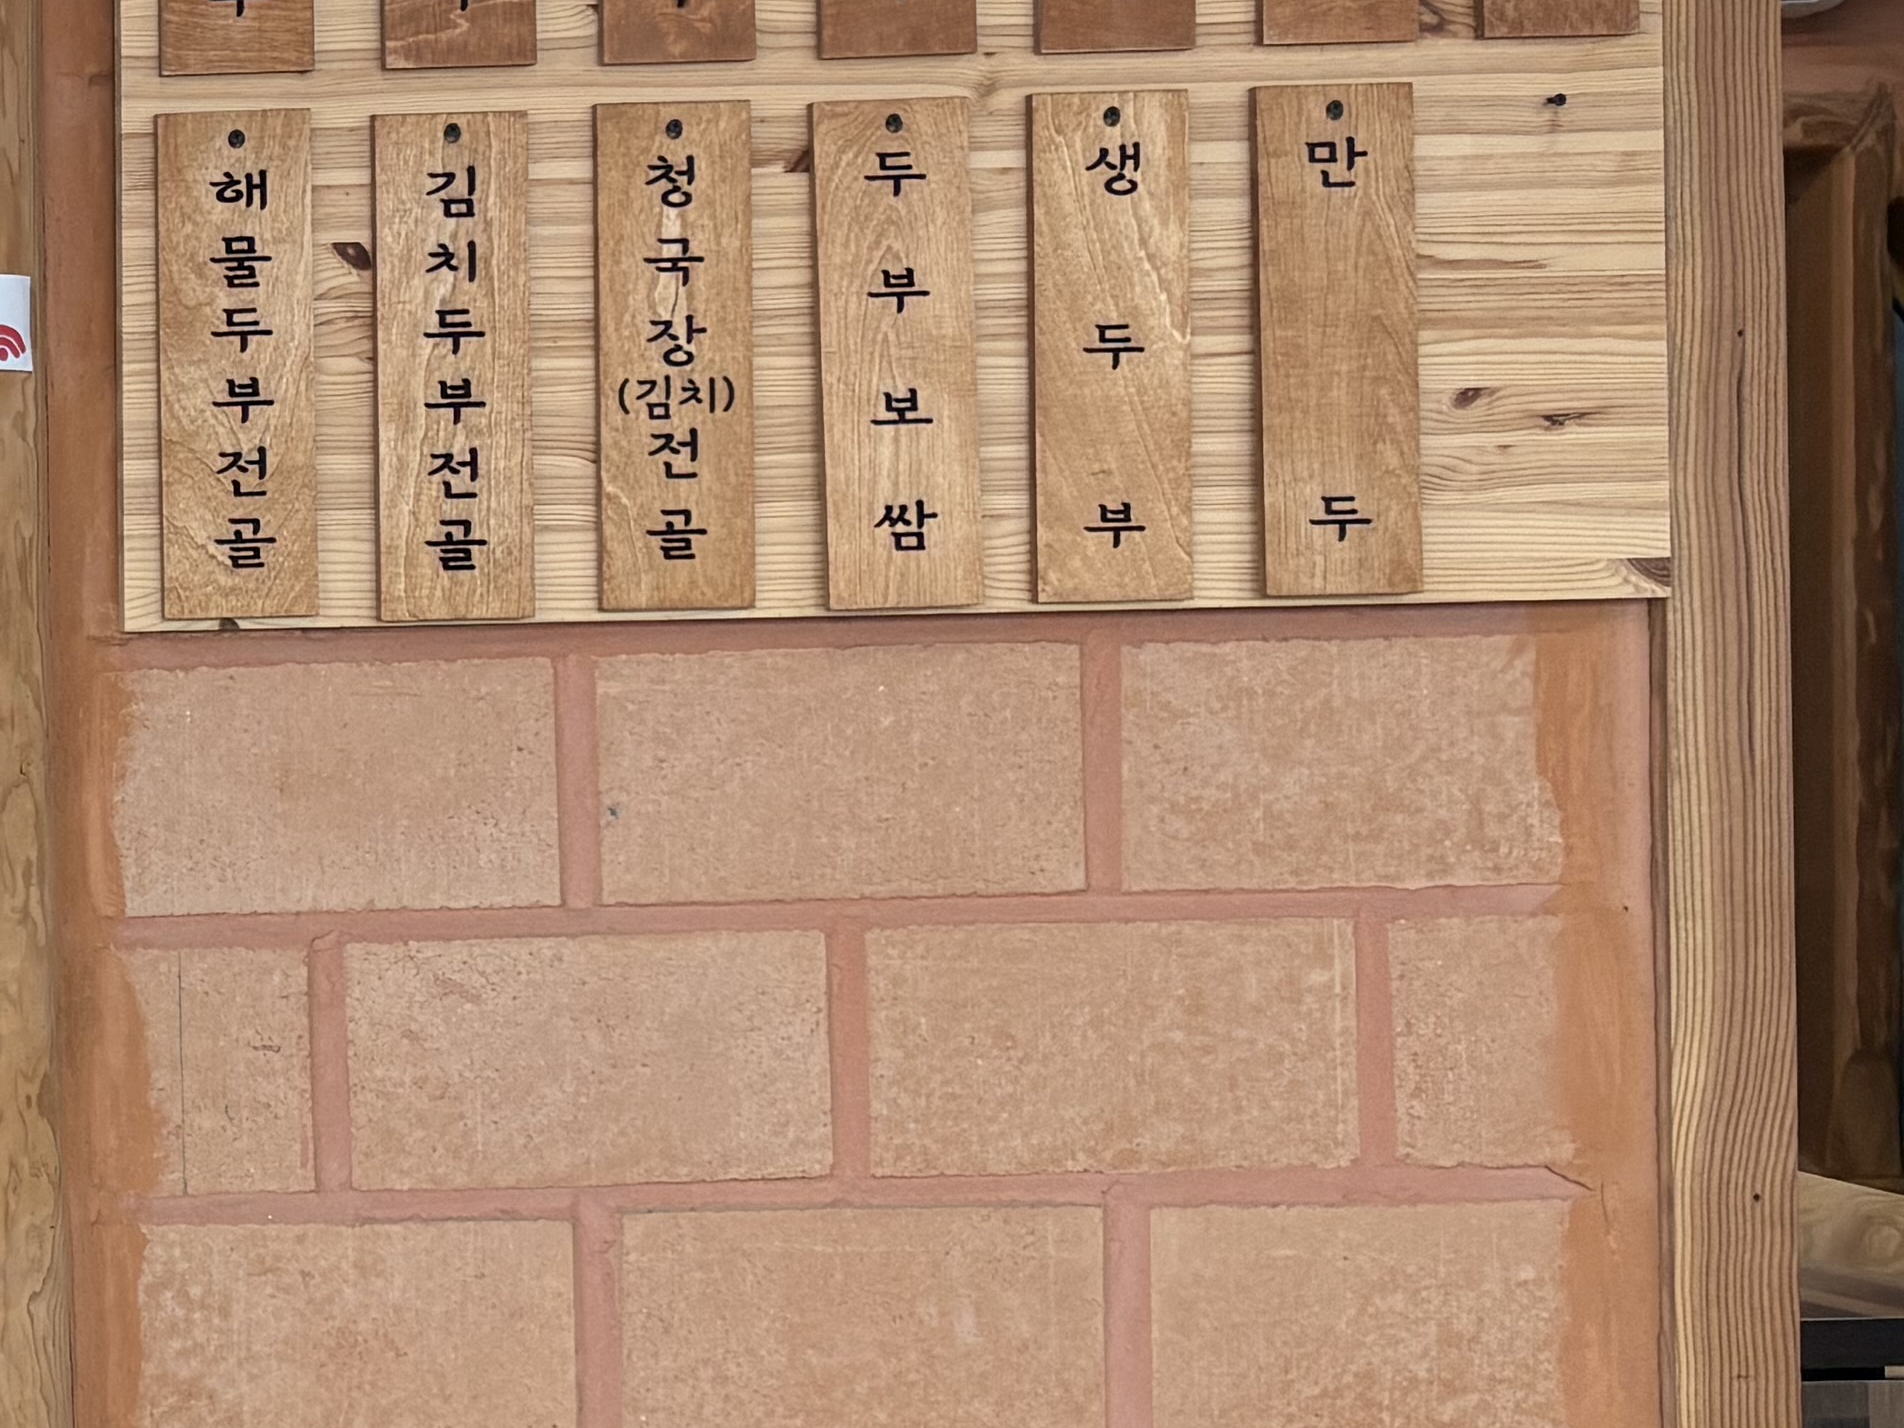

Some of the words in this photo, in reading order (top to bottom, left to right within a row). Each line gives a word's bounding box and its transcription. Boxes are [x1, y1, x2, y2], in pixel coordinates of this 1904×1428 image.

[209, 169, 277, 569] 해물두부전골
[423, 164, 488, 571] 김치두부전골
[864, 150, 938, 552] 두부보쌈
[1083, 141, 1146, 548] 생두부
[1304, 136, 1373, 542] 만두
